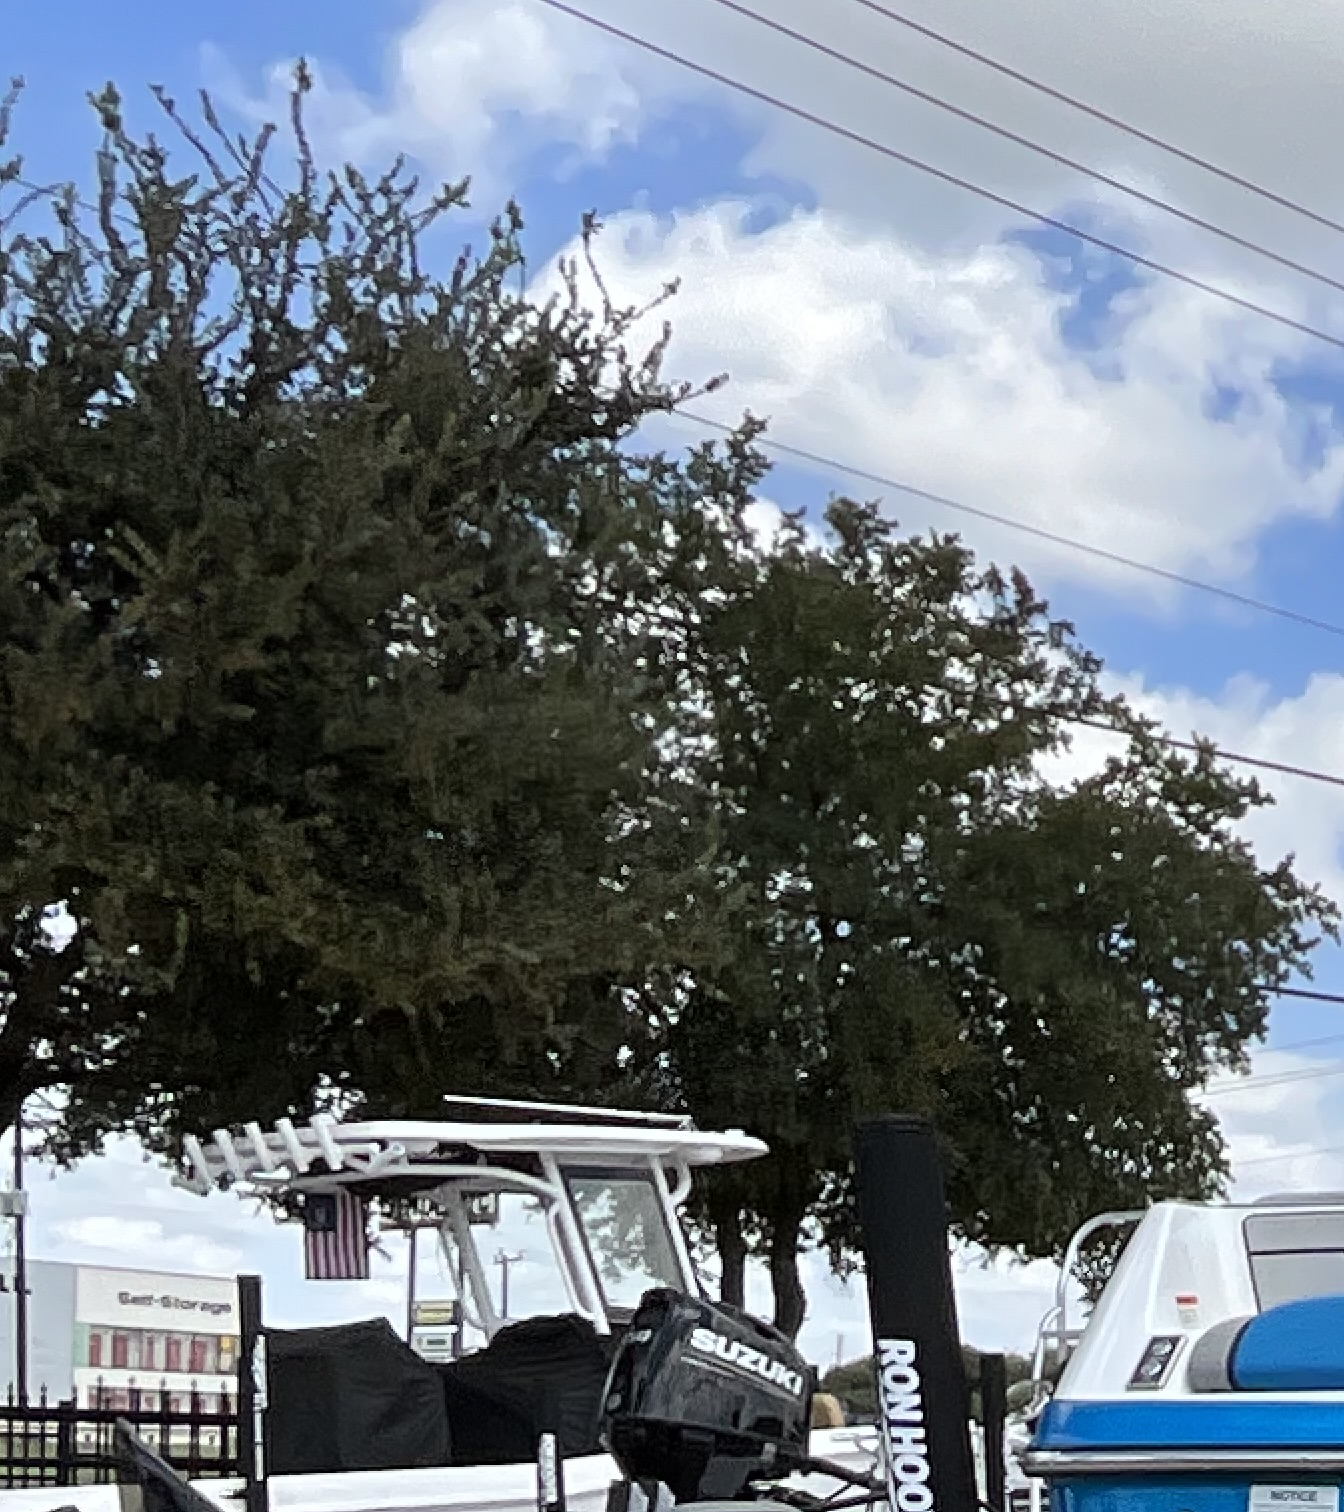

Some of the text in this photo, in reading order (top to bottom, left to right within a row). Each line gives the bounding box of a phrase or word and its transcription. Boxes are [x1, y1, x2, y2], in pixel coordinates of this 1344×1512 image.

[117, 1290, 232, 1316] Self-Storage
[690, 1328, 803, 1396] SUZUKI
[877, 1338, 925, 1422] RON
[1270, 1489, 1318, 1502] NOTICE
